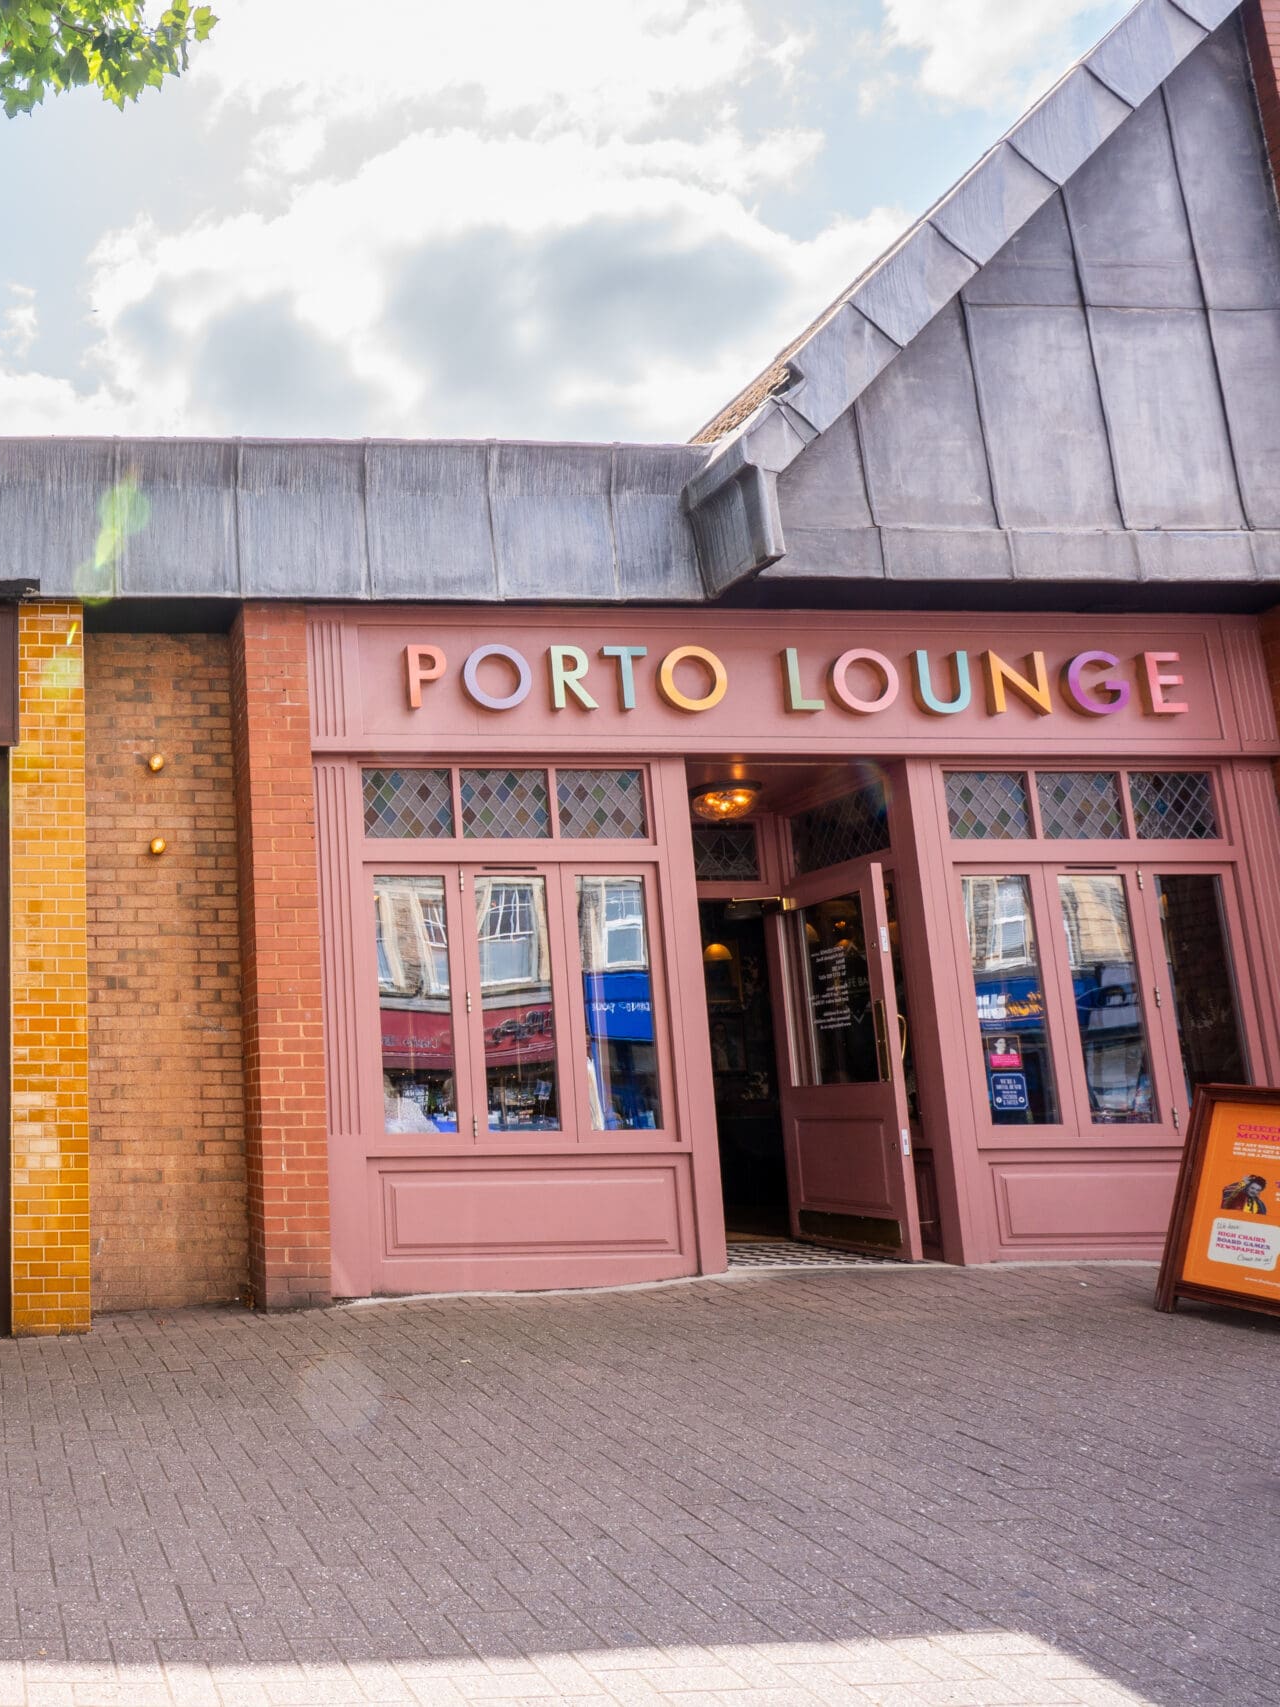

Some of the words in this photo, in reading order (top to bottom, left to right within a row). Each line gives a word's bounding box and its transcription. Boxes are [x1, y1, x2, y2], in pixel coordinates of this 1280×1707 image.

[404, 643, 729, 712] PORTO
[779, 647, 1190, 717] LOUNGE
[1216, 1237, 1242, 1246] BOARD
[1243, 1240, 1271, 1250] GAMES
[1218, 1231, 1237, 1239] HIGH
[1238, 1234, 1264, 1243] CHAIRS
[1215, 1243, 1266, 1256] NEWSPAPERS
